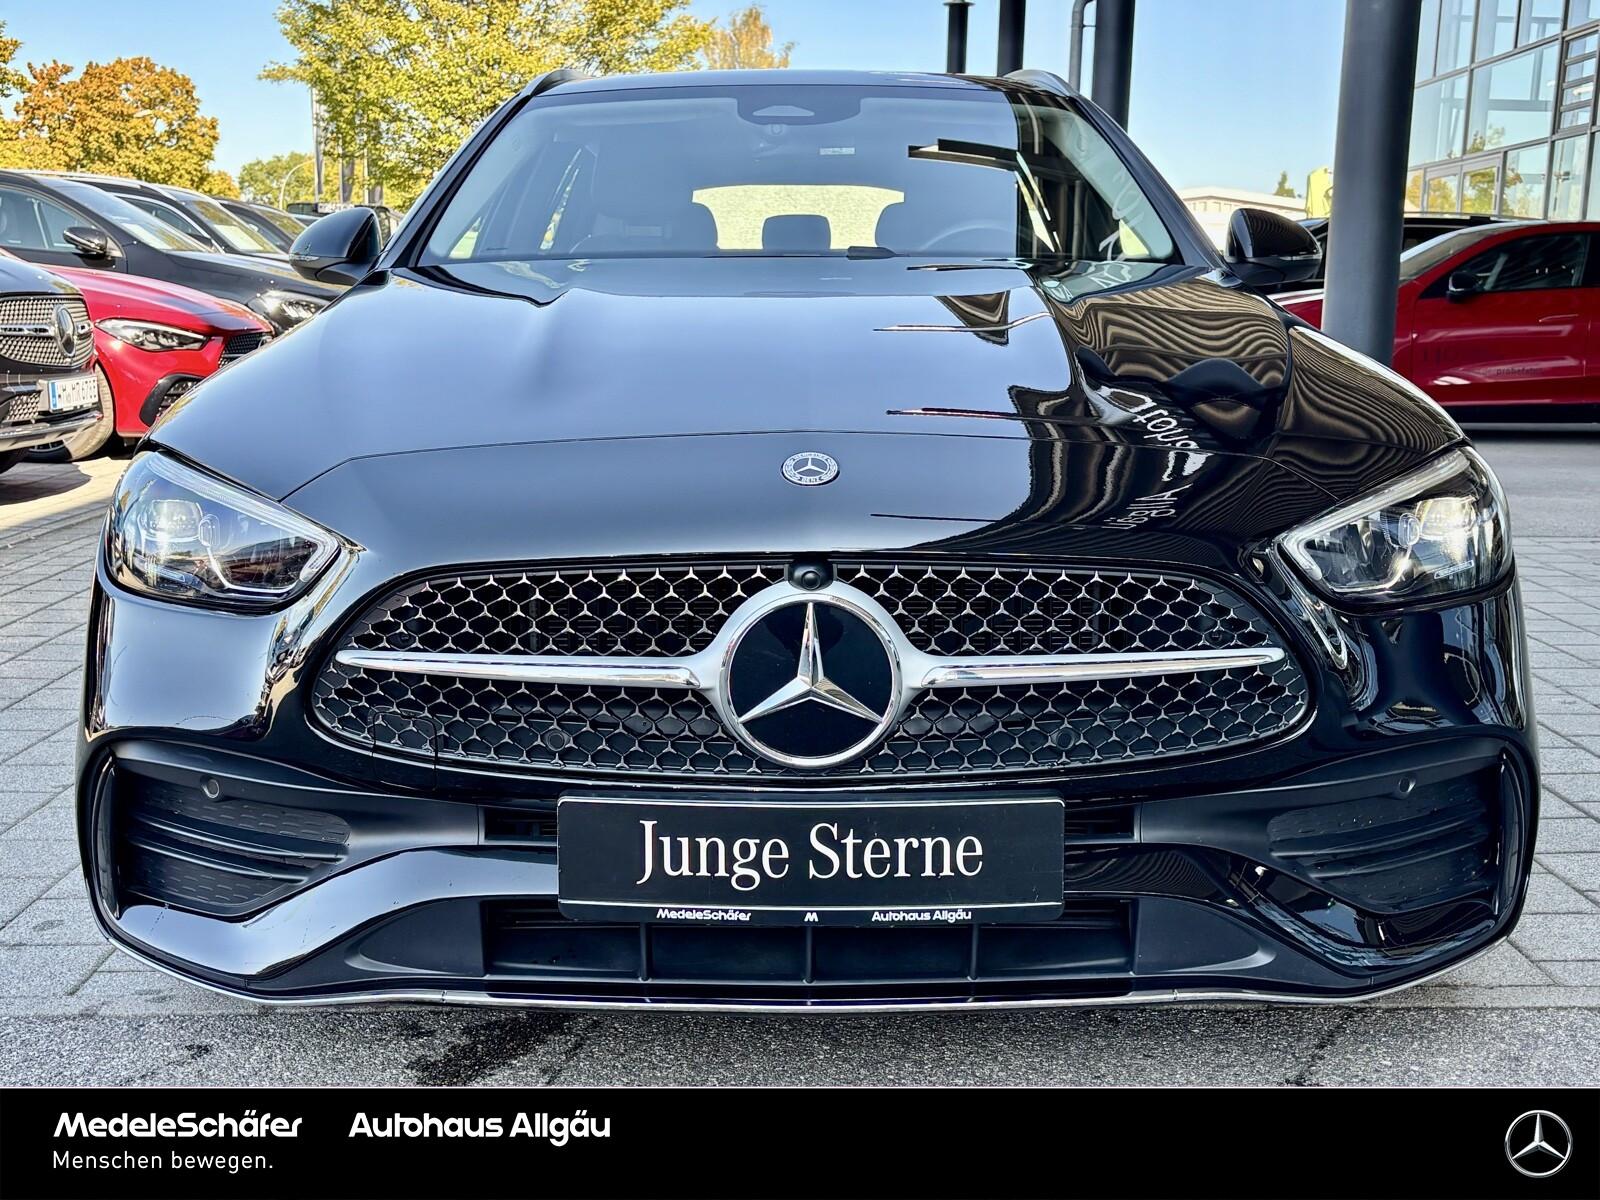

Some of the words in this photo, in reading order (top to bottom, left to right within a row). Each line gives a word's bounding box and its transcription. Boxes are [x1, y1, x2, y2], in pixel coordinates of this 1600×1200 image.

[637, 820, 790, 891] Junge
[809, 822, 983, 880] Sterne
[656, 908, 752, 921] MedeleSchäfer
[872, 910, 931, 922] Autohaus
[932, 908, 972, 923] Allgäu
